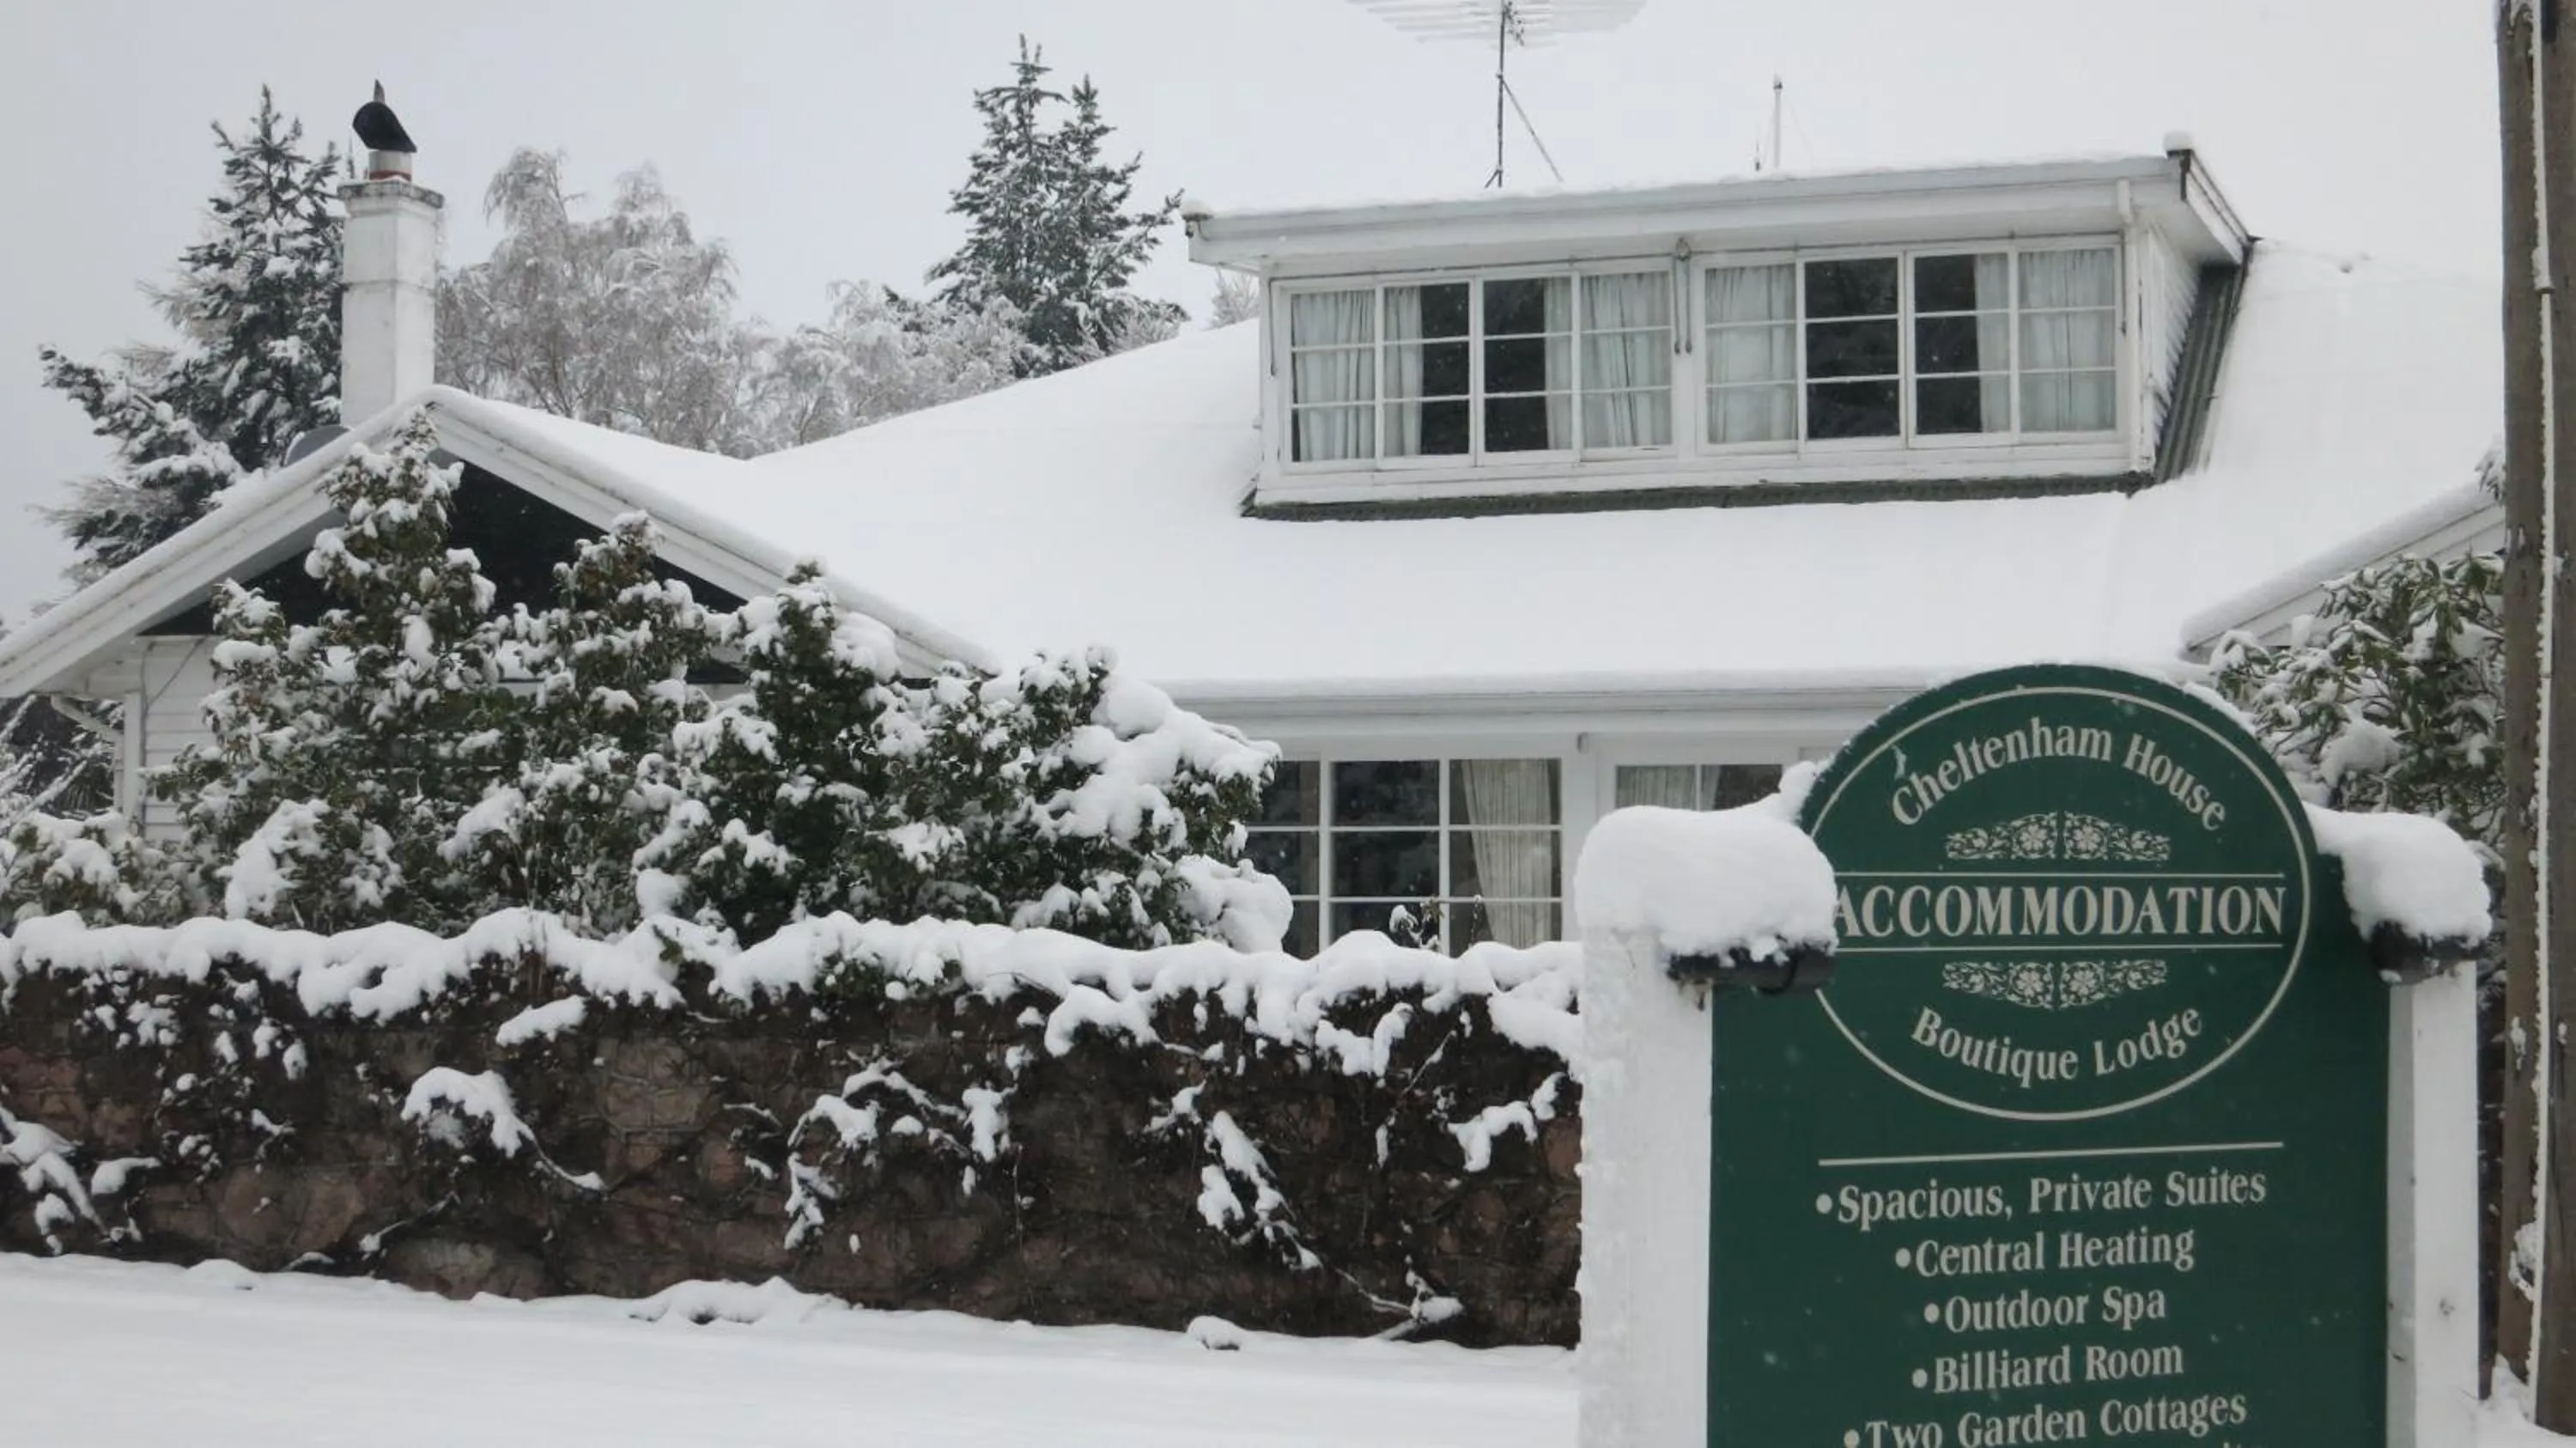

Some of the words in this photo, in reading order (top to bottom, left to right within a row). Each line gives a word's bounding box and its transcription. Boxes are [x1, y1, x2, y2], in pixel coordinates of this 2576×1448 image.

[1892, 716, 2112, 825] Cheltenham
[2123, 733, 2226, 830] House
[1834, 885, 2286, 937] ACCOMMODATION
[1911, 1006, 2079, 1089] Boutique
[2093, 1008, 2202, 1076] Lodge
[1838, 1178, 2013, 1232] Spacious,
[2029, 1172, 2153, 1214] Private
[2166, 1166, 2266, 1207] Suites
[1915, 1231, 2045, 1278] Central
[2058, 1226, 2195, 1272] Heating
[1944, 1288, 2089, 1334] Outdoor
[2101, 1286, 2166, 1331] Spa
[1934, 1344, 2071, 1394] Billiard
[2085, 1345, 2184, 1382] Room
[1864, 1420, 1943, 1448] Two
[1957, 1403, 2087, 1447] Garden
[2099, 1394, 2247, 1438] Cottages
